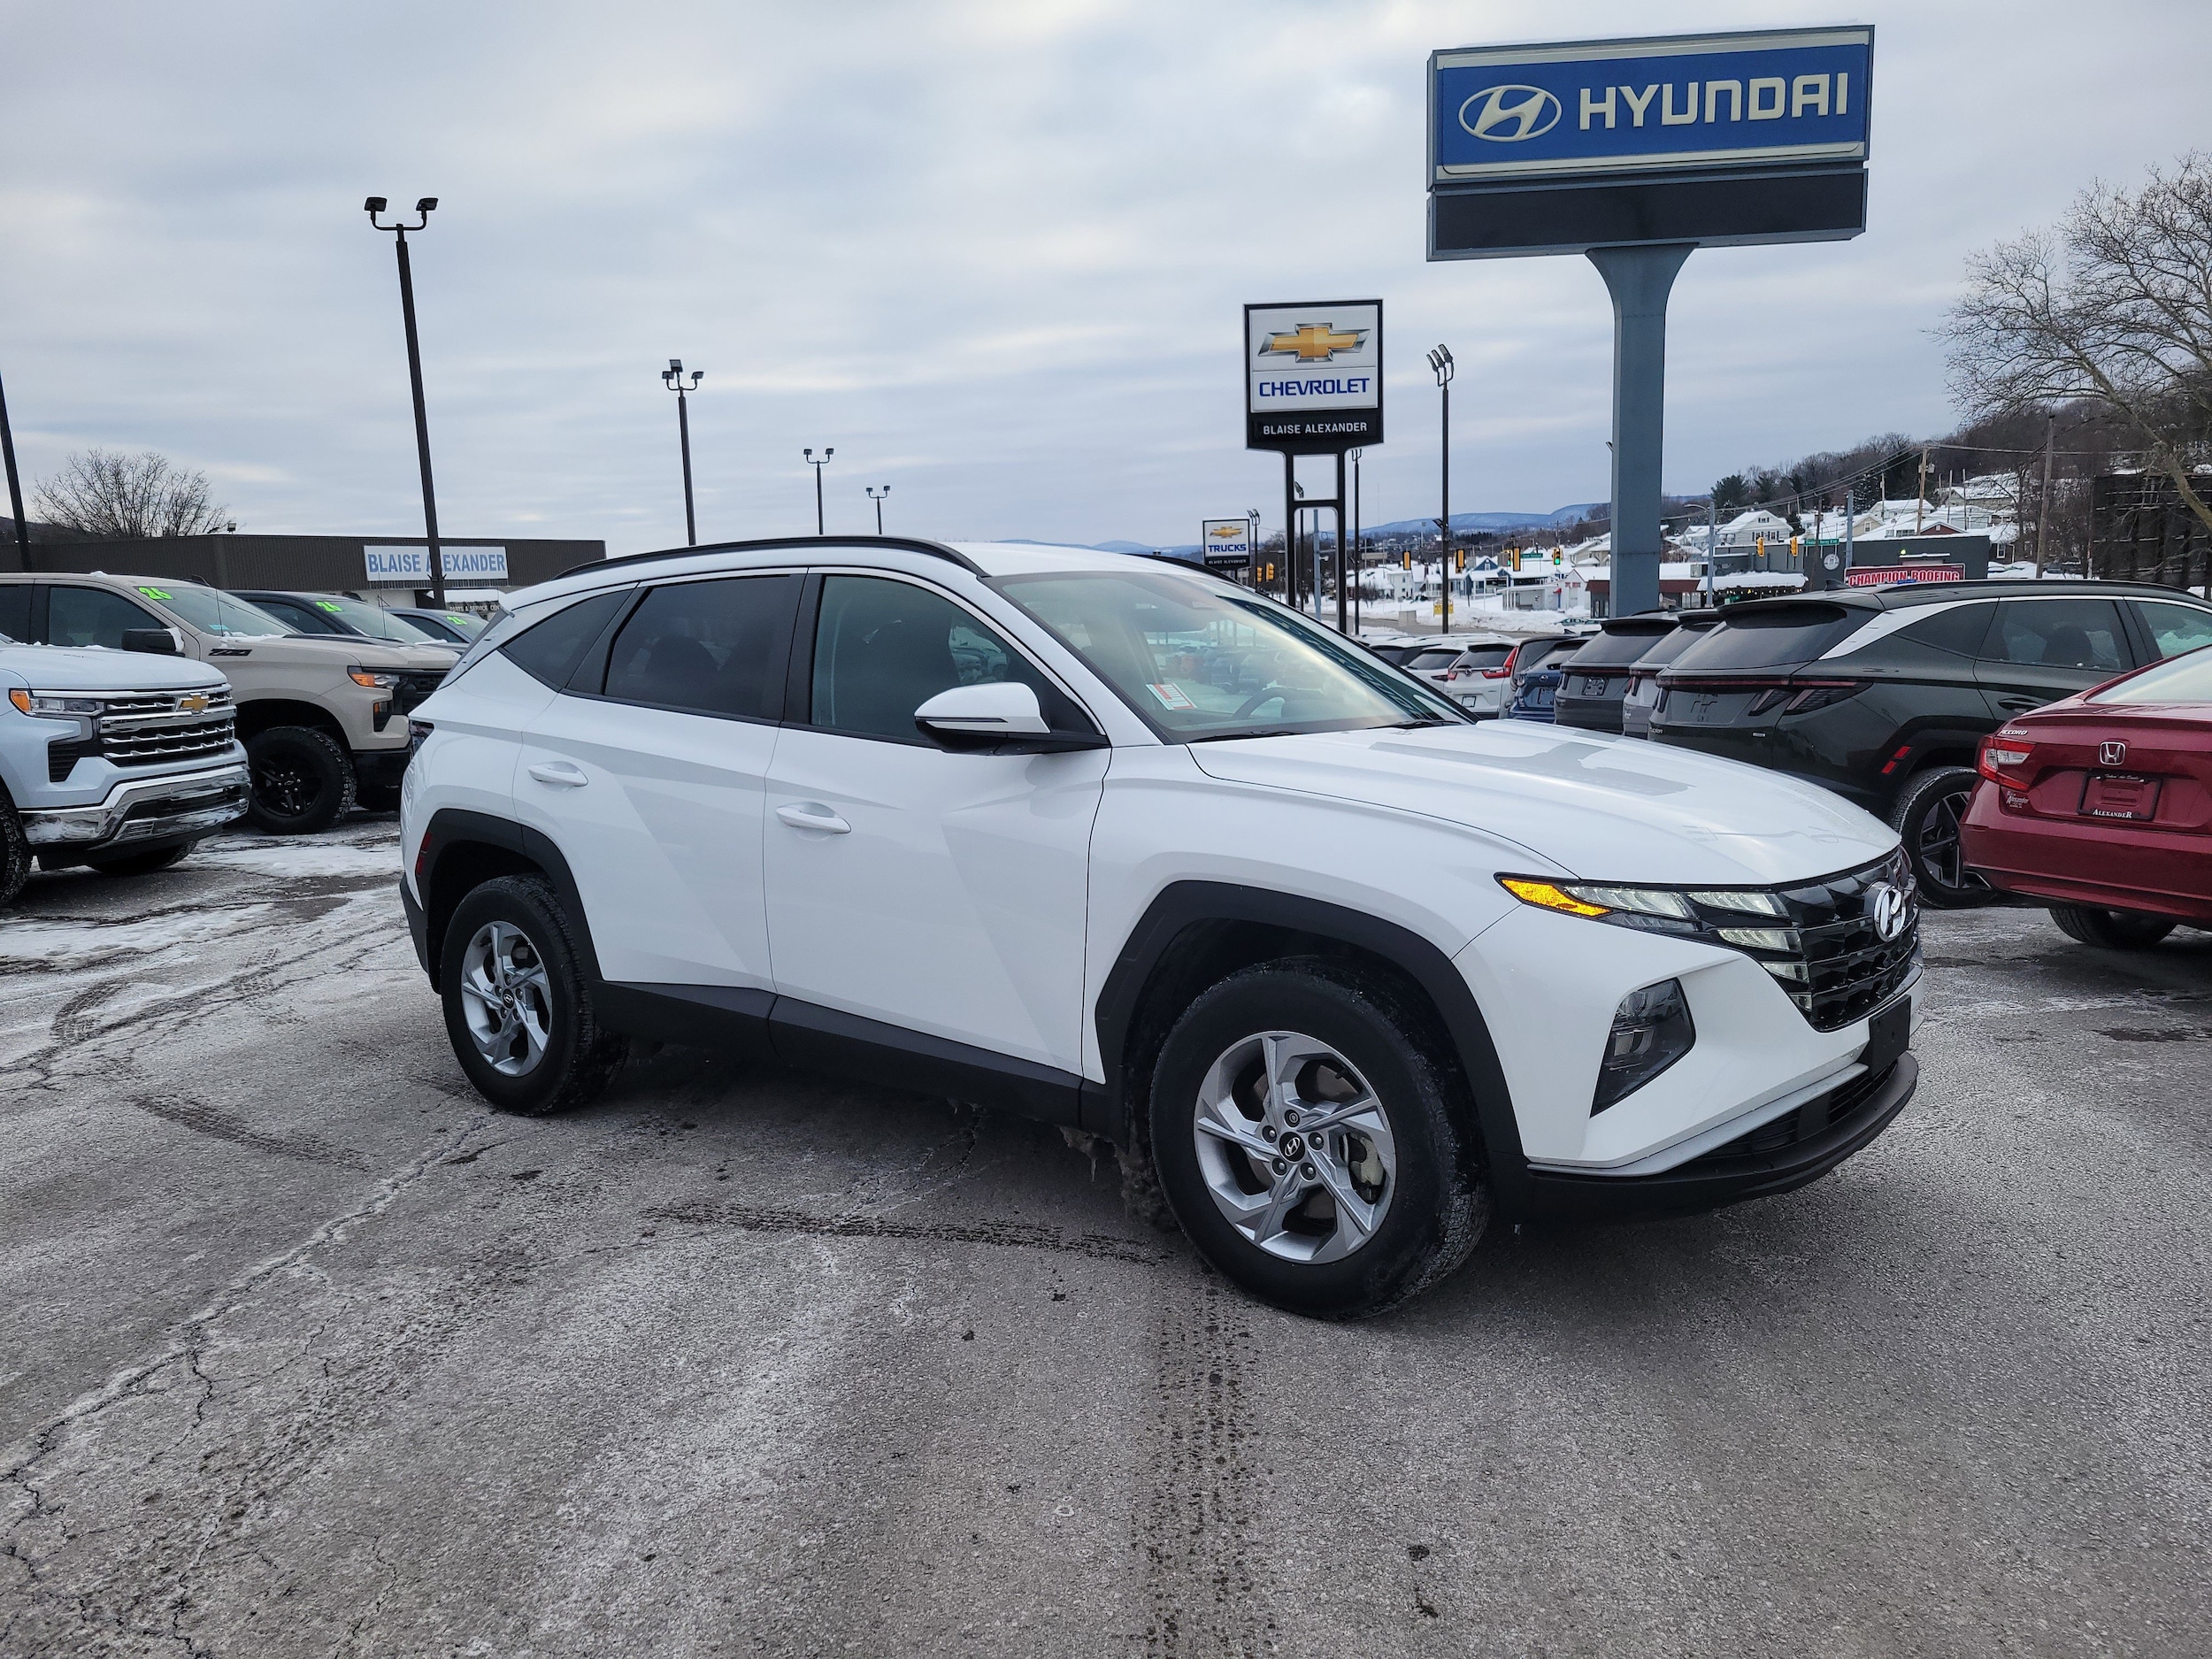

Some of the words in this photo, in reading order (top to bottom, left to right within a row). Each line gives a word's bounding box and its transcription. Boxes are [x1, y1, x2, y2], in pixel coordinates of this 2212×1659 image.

[1579, 73, 1848, 130] HYUNDAI
[1259, 378, 1370, 397] CHEVROLET
[1263, 425, 1302, 435] BLAISE
[1305, 422, 1367, 434] ALEXANDER
[367, 554, 421, 572] BLAISE
[426, 554, 506, 572] EXANDER
[1849, 570, 1908, 588] CHAMPION
[1911, 570, 1960, 581] ROOFING
